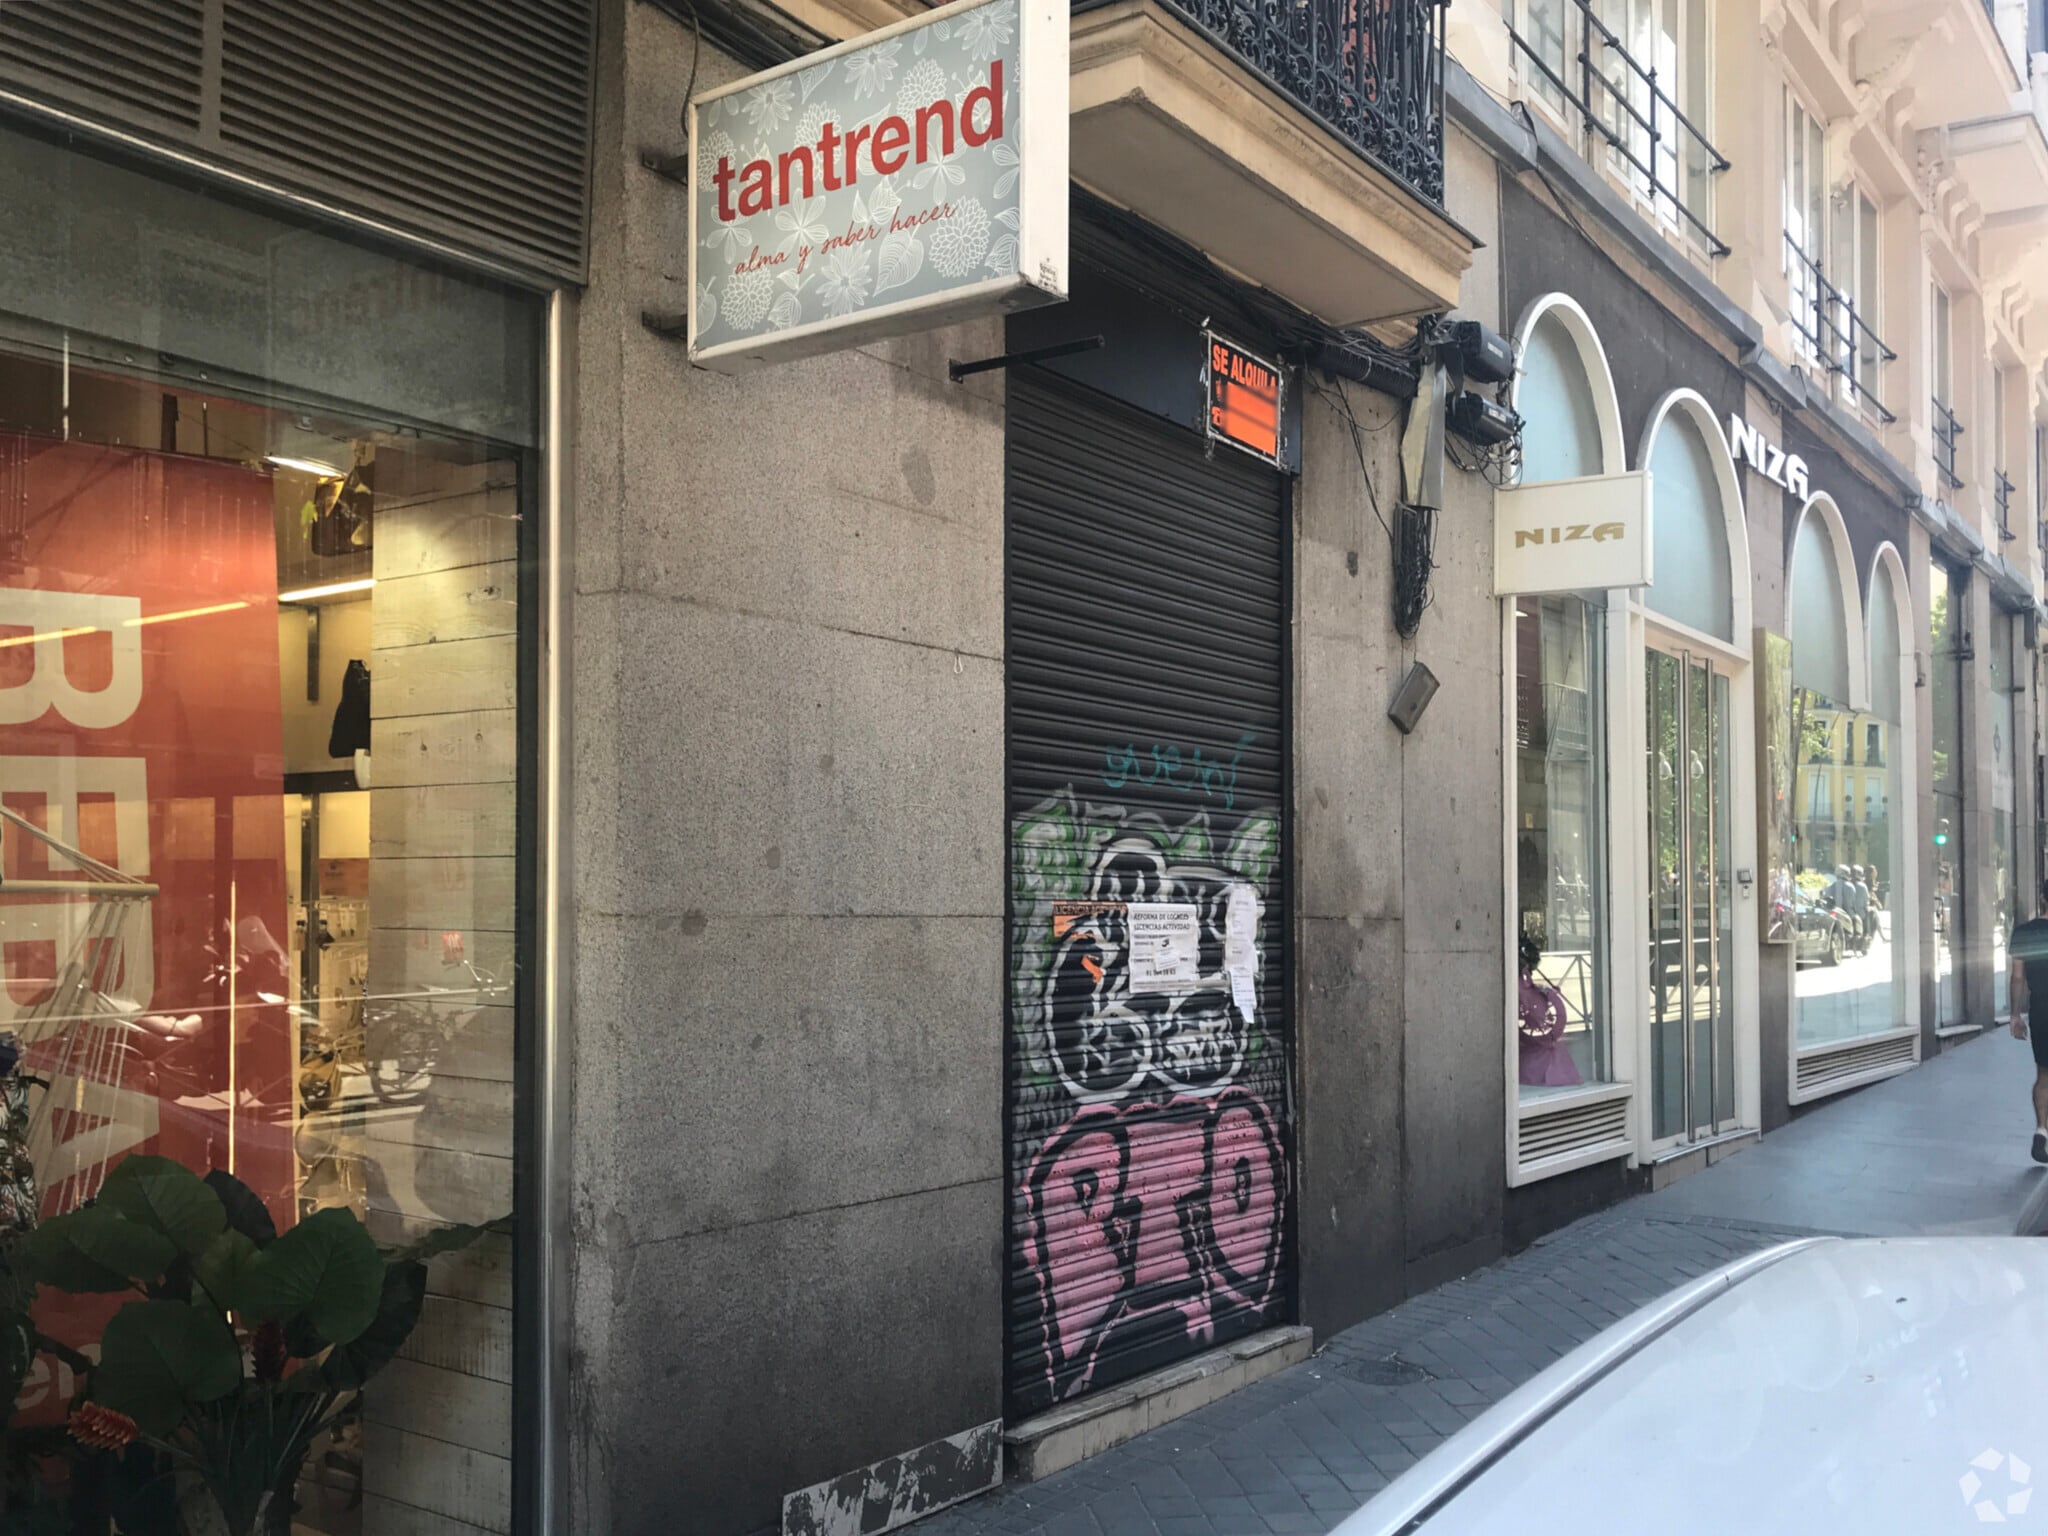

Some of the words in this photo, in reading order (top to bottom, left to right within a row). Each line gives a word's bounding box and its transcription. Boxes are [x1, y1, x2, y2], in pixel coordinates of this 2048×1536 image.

[712, 59, 1004, 223] tantrend
[735, 245, 790, 275] alma
[798, 243, 813, 275] y
[820, 221, 882, 255] saber
[889, 202, 959, 234] hacer
[1212, 344, 1228, 376] SE
[1731, 412, 1809, 502] NIZA
[1515, 522, 1625, 549] NIZA
[1159, 913, 1166, 921] DE
